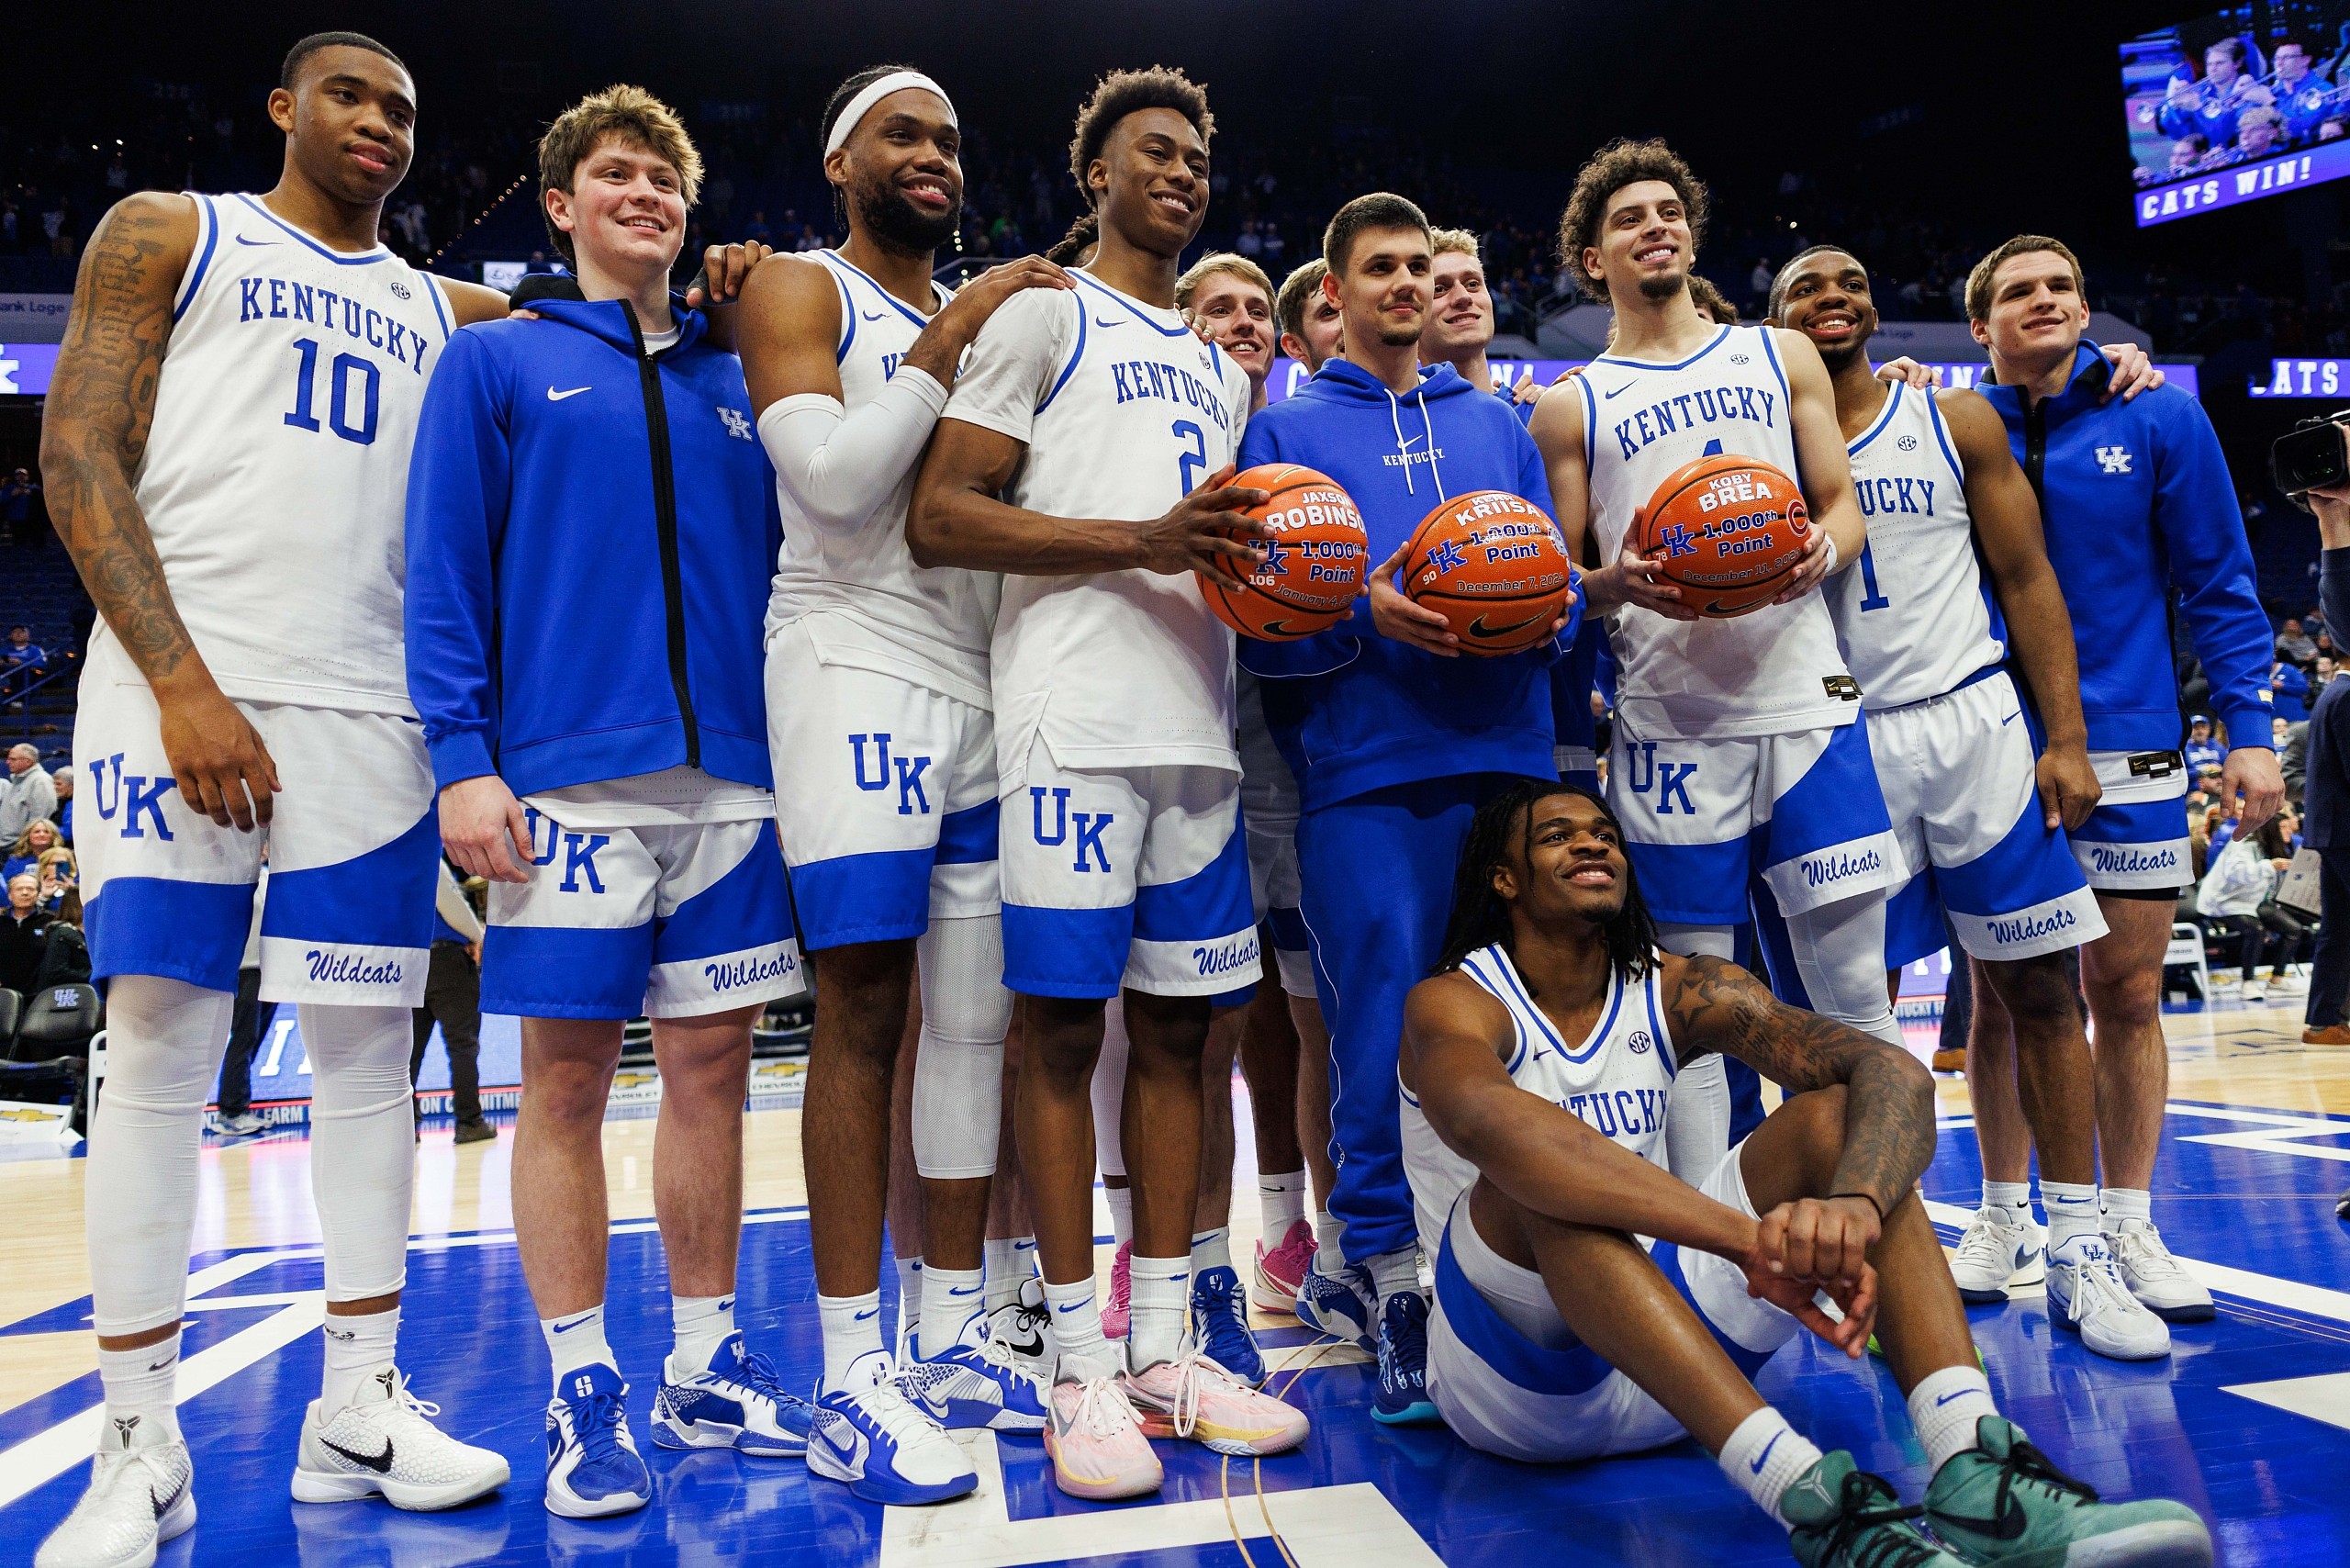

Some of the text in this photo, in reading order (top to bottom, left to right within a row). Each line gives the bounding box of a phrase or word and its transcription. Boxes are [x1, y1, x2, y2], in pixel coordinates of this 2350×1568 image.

[2143, 155, 2311, 219] CATS WIN!
[392, 283, 410, 299] SEC
[241, 277, 428, 375] KENTUCKY
[1731, 354, 1749, 364] SEC
[284, 338, 381, 445] 10
[1111, 361, 1229, 431] KENTUCKY
[717, 407, 753, 442] UK
[1615, 386, 1774, 462] KENTUCKY
[1382, 448, 1444, 466] KENTUCKY
[1898, 436, 1917, 450] SEC
[1171, 420, 1207, 498] 2
[2095, 445, 2133, 476] UK
[1698, 482, 1773, 513] BREA
[1708, 473, 1752, 491] KOBY
[1302, 492, 1353, 508] JAXSON
[1455, 501, 1542, 527] KRIISA
[1486, 542, 1540, 565] Point
[1660, 523, 1698, 558] UK
[1717, 533, 1774, 558] Point
[1427, 539, 1468, 576] UK
[1655, 551, 1668, 562] 78
[1249, 574, 1276, 587] 106
[1309, 565, 1356, 583] Point
[1422, 570, 1438, 587] 90
[1456, 578, 1527, 594] December
[1528, 577, 1539, 590] 7,
[1684, 568, 1753, 583] December
[1860, 534, 1890, 612] 1
[1274, 584, 1327, 608] January
[848, 733, 932, 815] UK
[1626, 742, 1698, 815] UK
[89, 752, 178, 842] UK
[1030, 786, 1114, 873] UK
[525, 807, 610, 894] UK
[2091, 847, 2177, 873] Wildcats
[1801, 849, 1882, 888] Wildcats
[1986, 909, 2076, 945] Wildcats
[306, 949, 403, 985] Wildcats
[704, 951, 796, 992] Wildcats
[1192, 937, 1259, 976] Wildcats
[1628, 1032, 1651, 1054] SEC
[420, 1096, 441, 1114] ON
